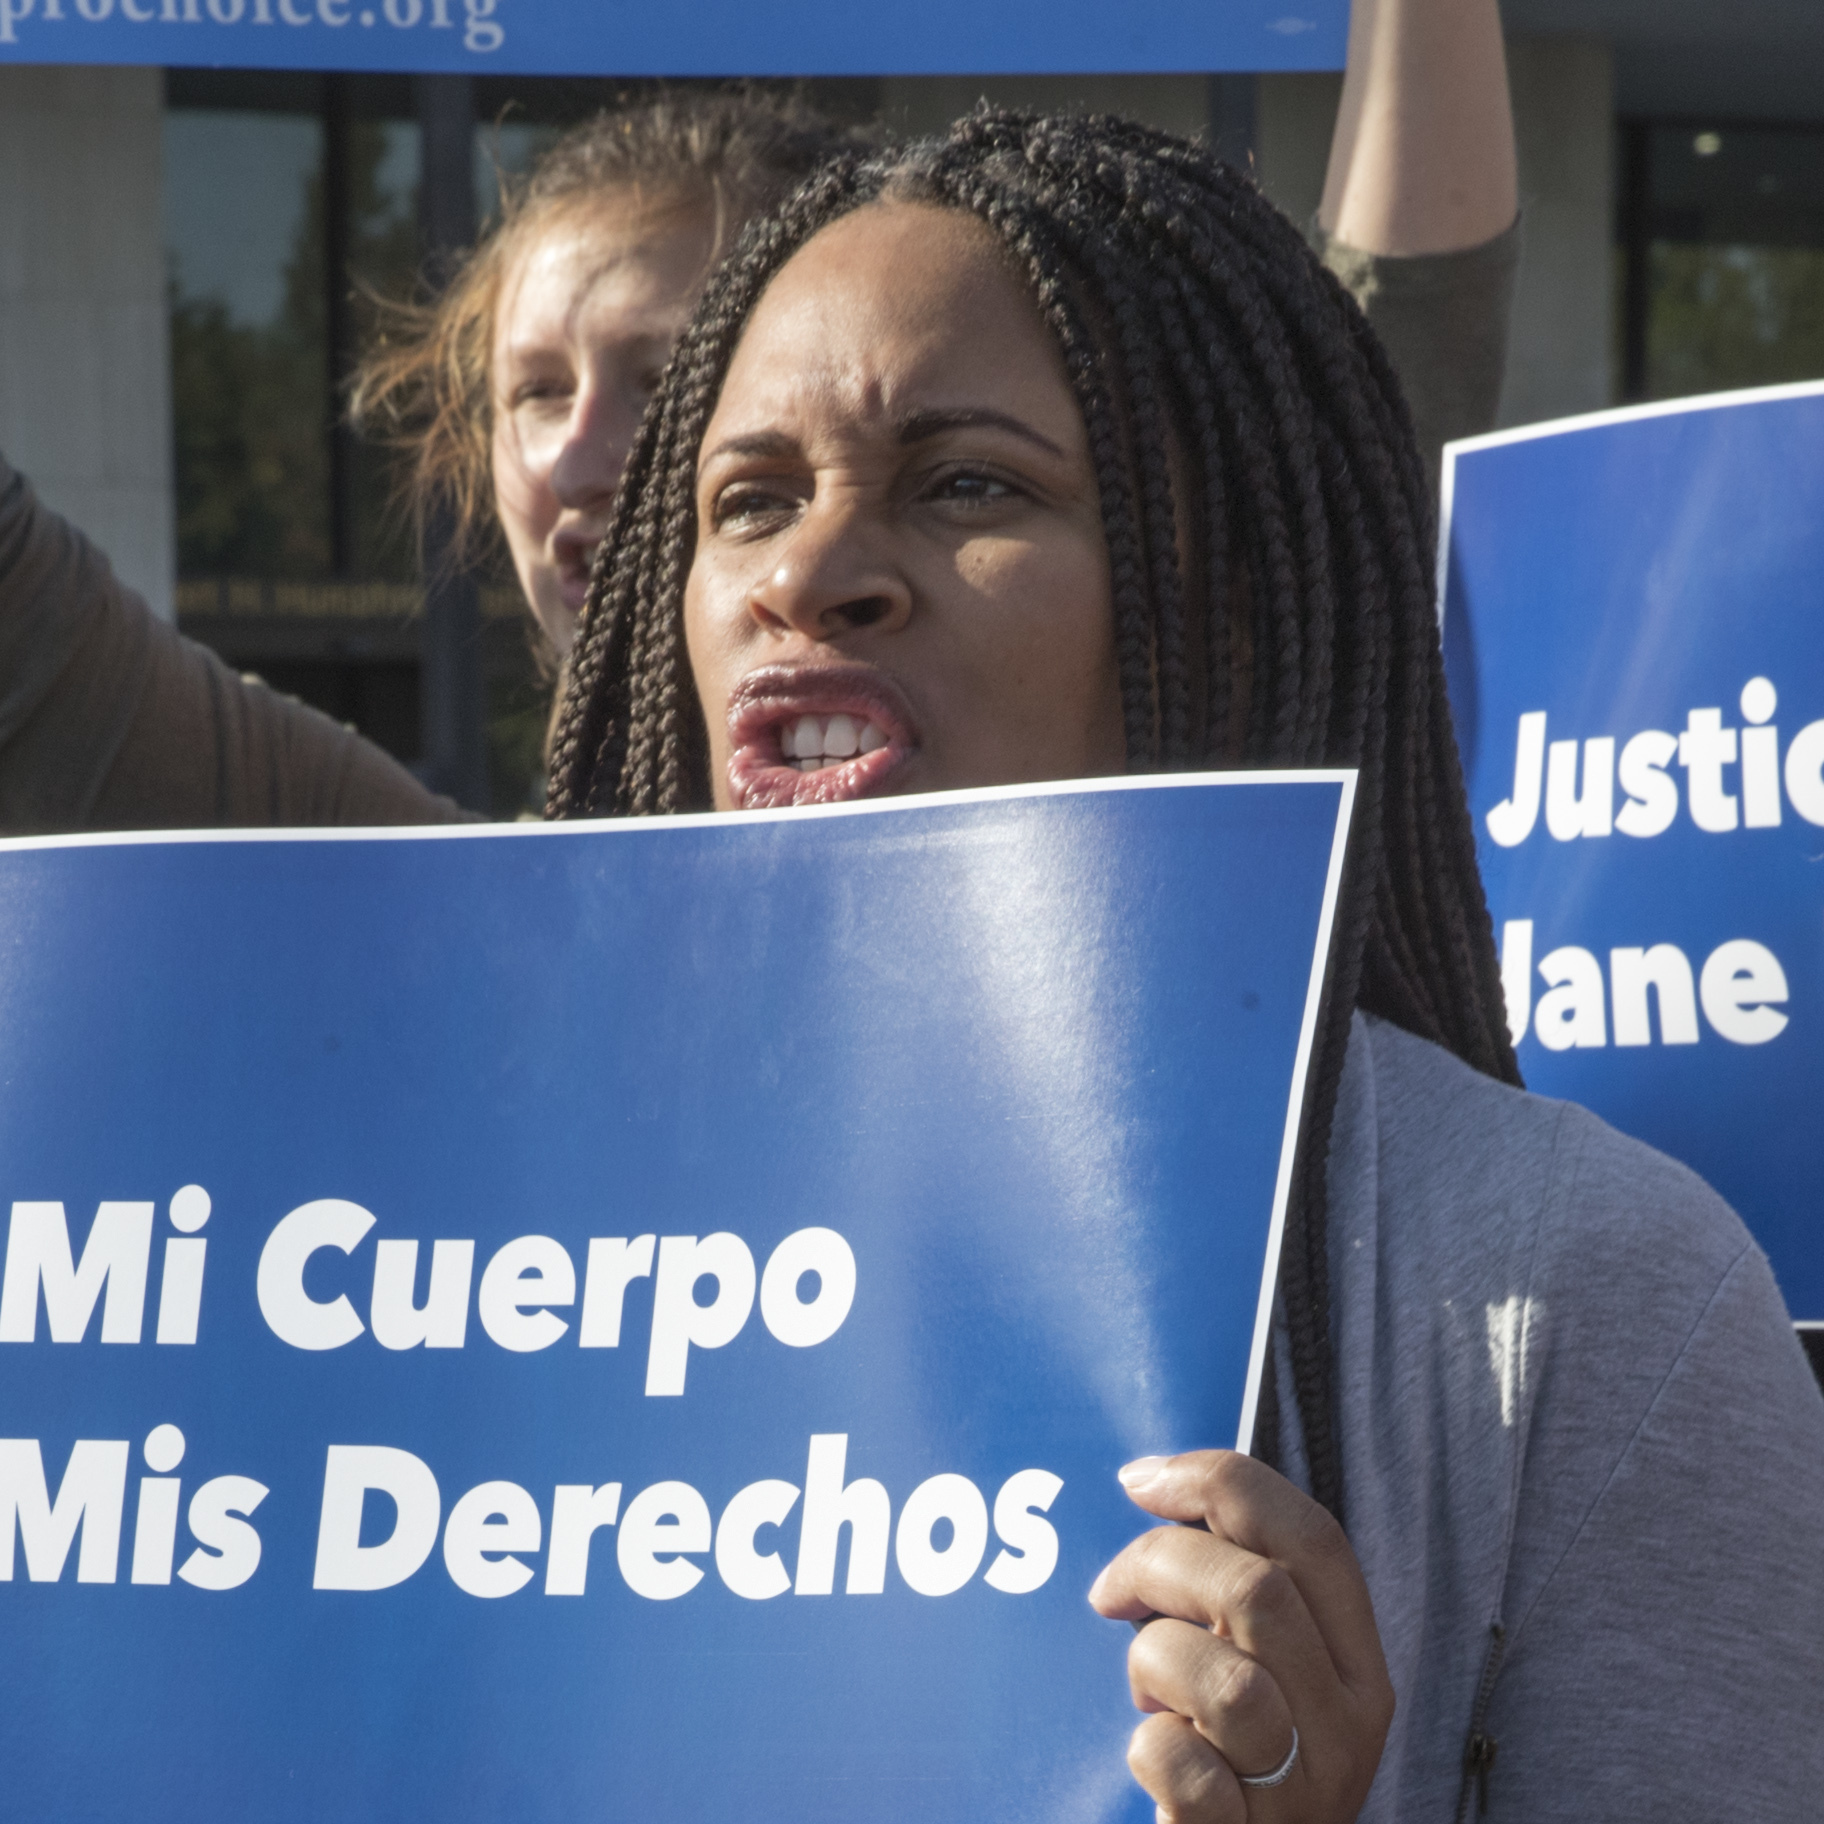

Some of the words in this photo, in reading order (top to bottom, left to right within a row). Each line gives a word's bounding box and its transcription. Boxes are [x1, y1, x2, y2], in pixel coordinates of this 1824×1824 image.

[1499, 918, 1789, 1052] Jane
[256, 1198, 858, 1397] Cuerpo
[312, 1432, 1065, 1601] Derechos
